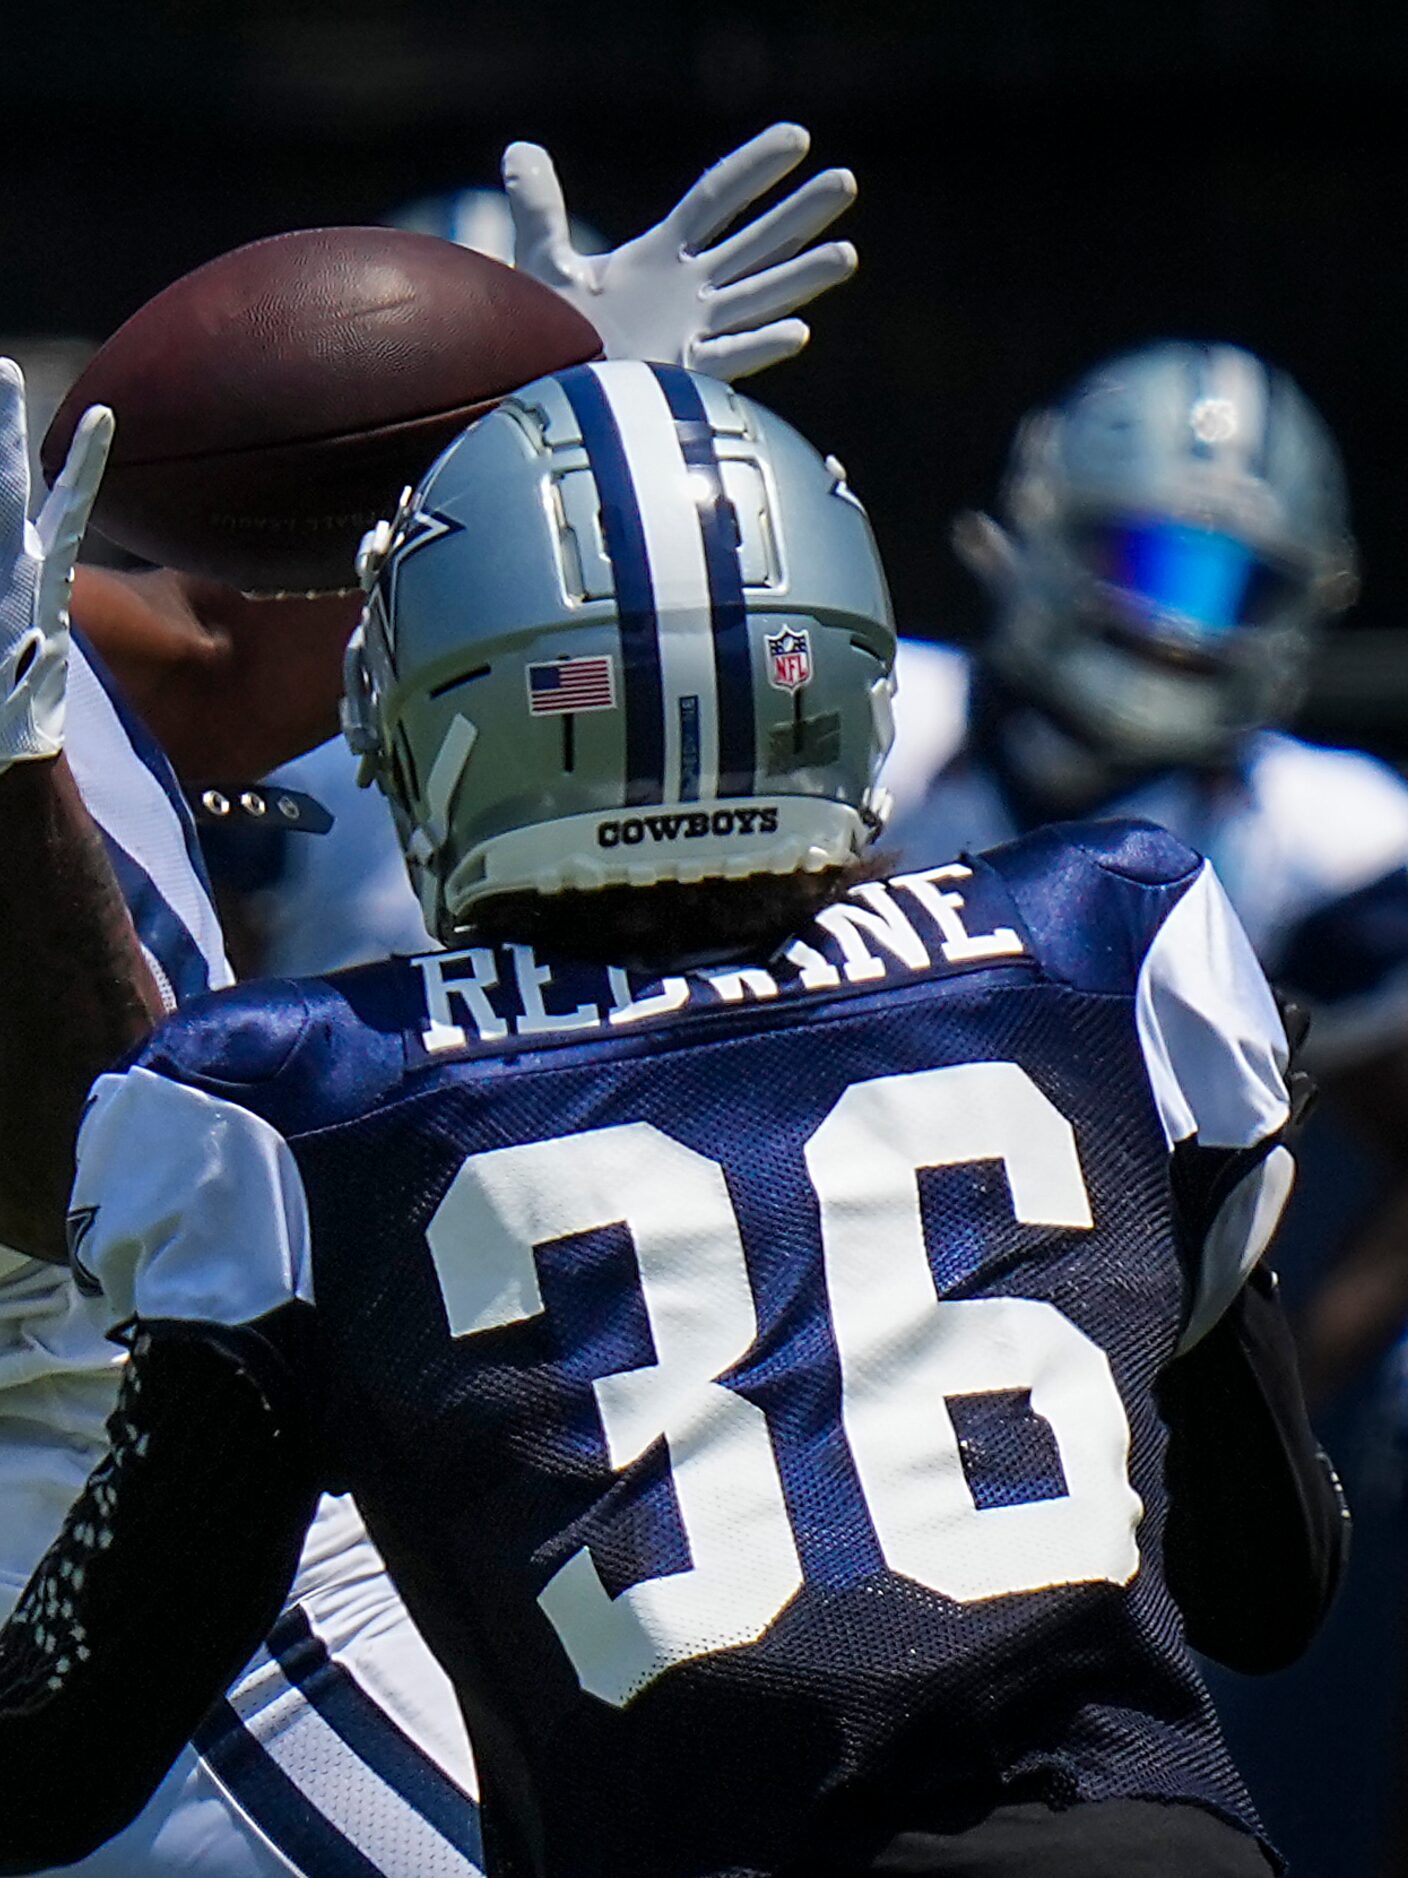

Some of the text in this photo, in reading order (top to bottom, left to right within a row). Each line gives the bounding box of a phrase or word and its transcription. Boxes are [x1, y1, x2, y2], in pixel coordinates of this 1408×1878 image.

[774, 652, 808, 684] NFL
[597, 807, 779, 848] COWBOYS
[425, 1060, 1144, 1709] 36
